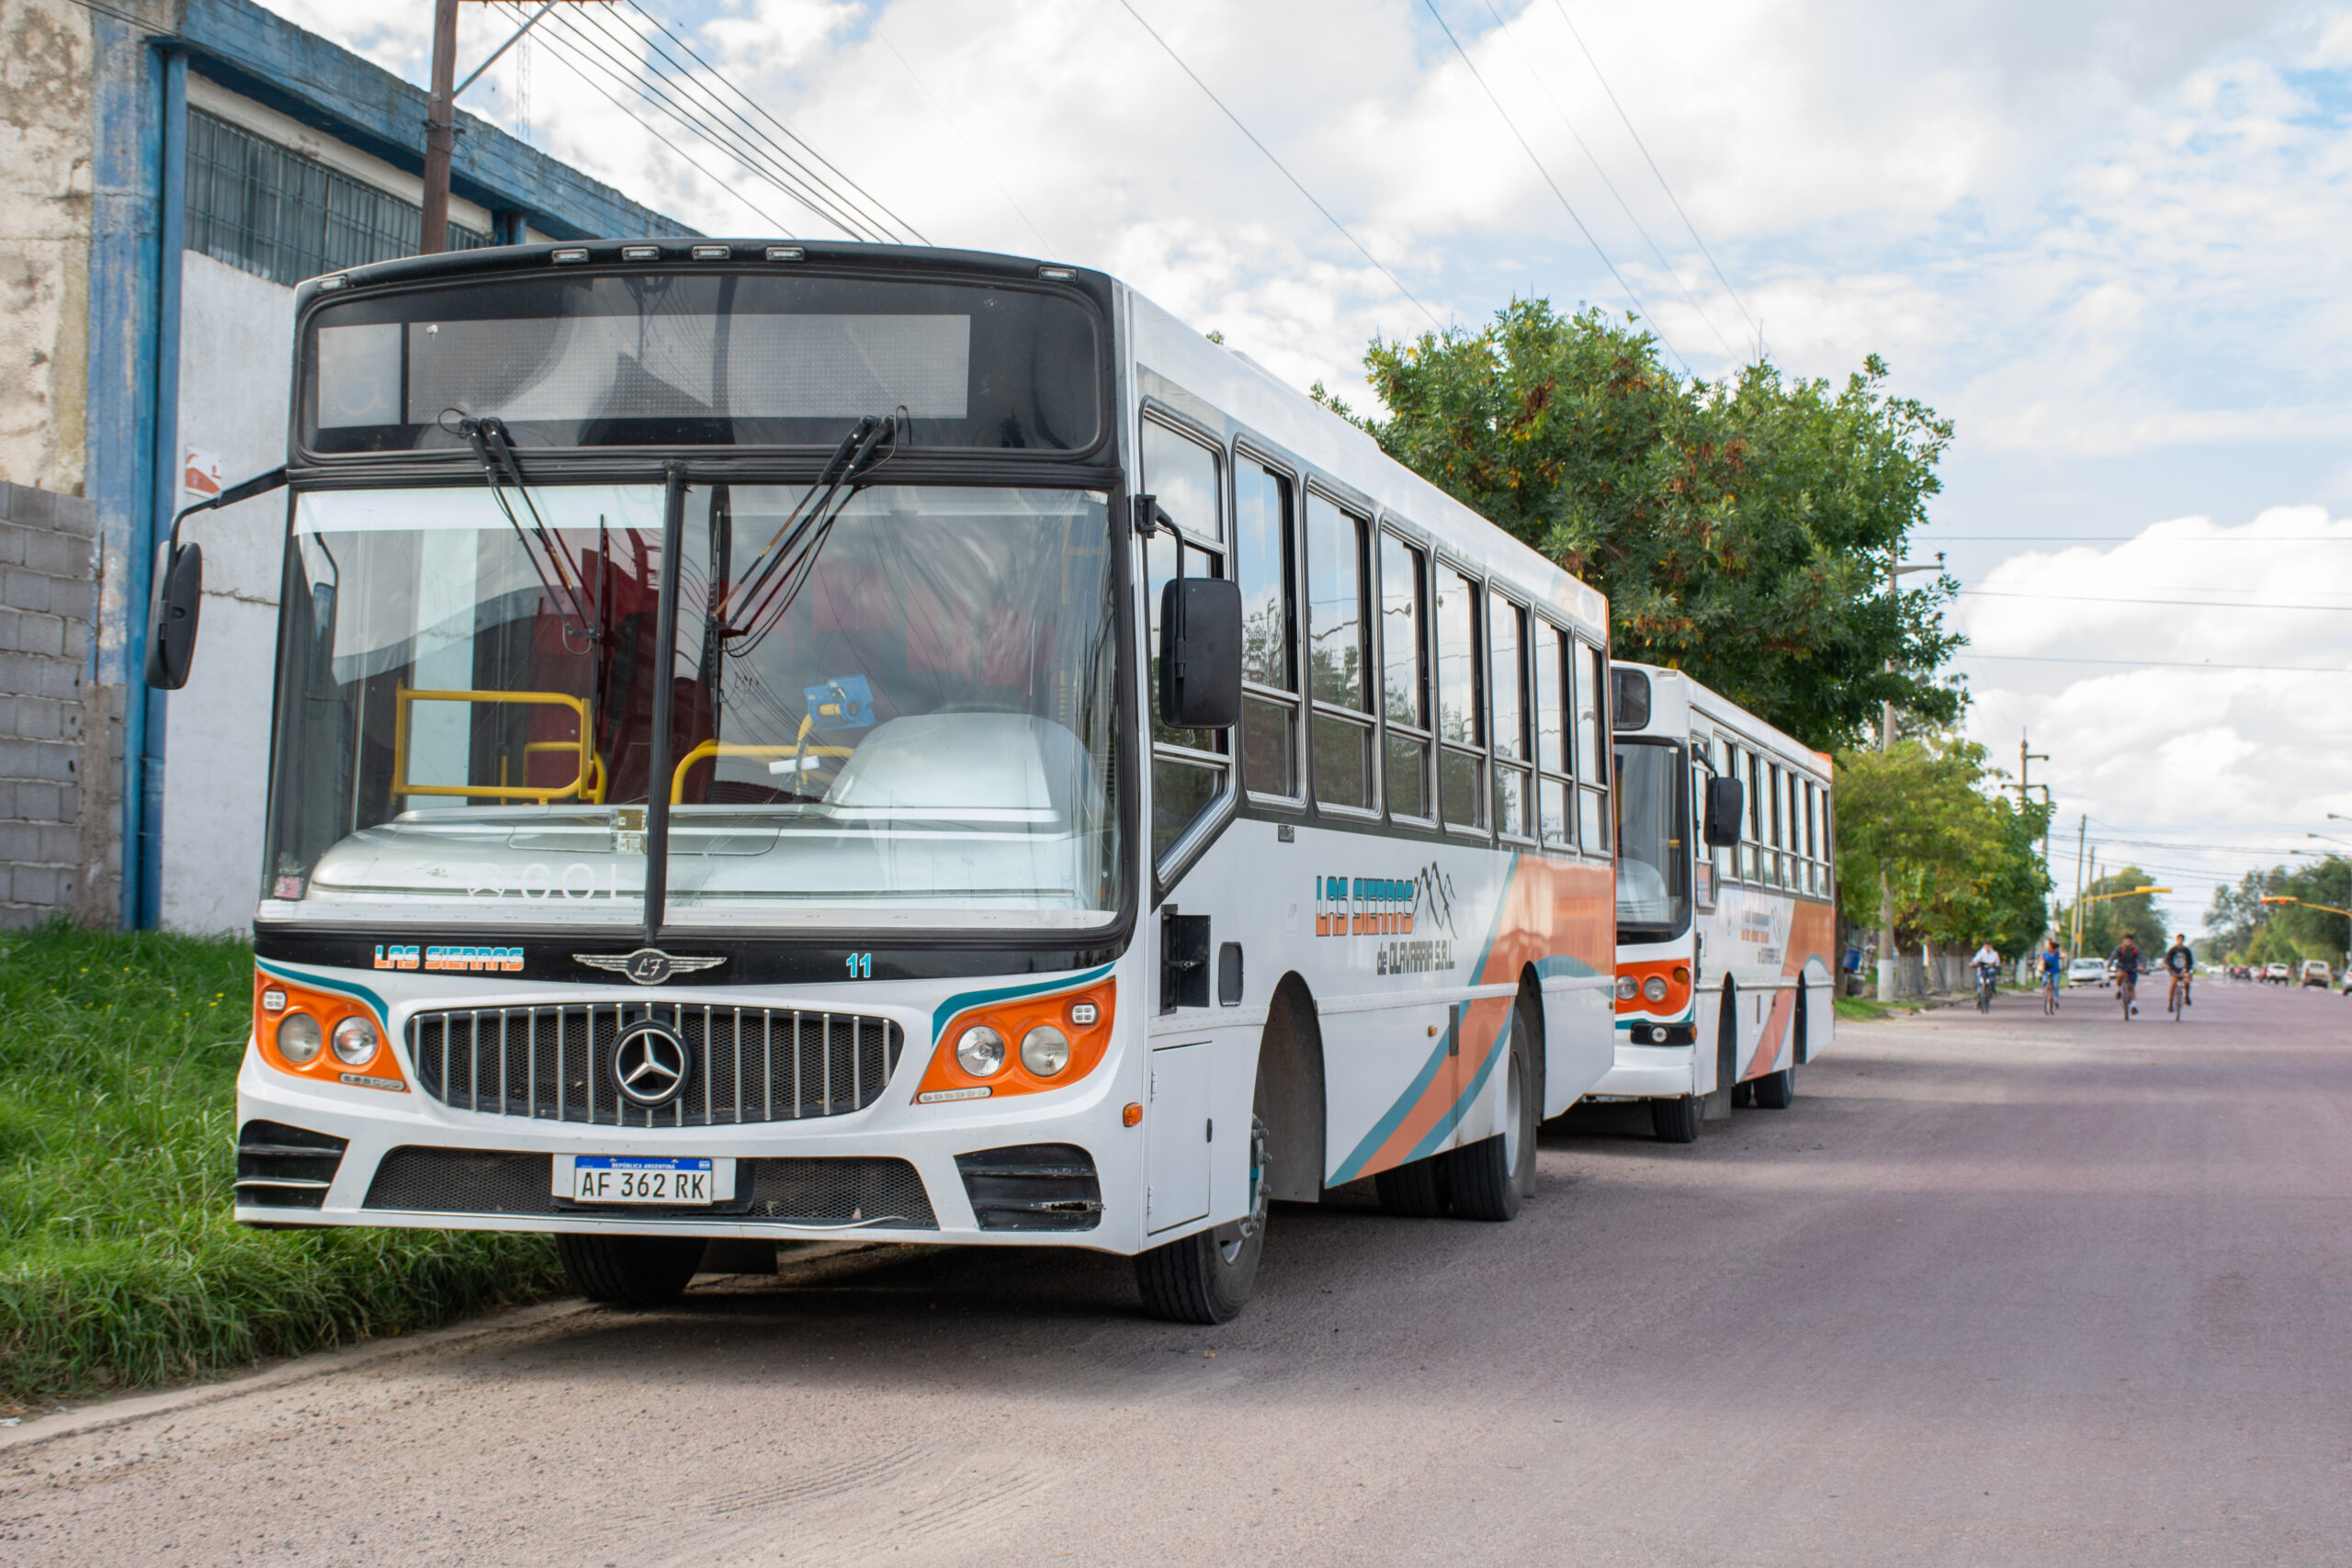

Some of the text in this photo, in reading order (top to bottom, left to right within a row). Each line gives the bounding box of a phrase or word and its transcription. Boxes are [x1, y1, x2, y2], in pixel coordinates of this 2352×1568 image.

[1317, 875, 1413, 937] LAS SIERRAS
[374, 945, 525, 972] LAS SIERRAS
[846, 953, 872, 978] 11
[1377, 942, 1386, 976] de
[1389, 940, 1433, 975] OLAVARRIA
[582, 1172, 705, 1199] AF 362 RK
